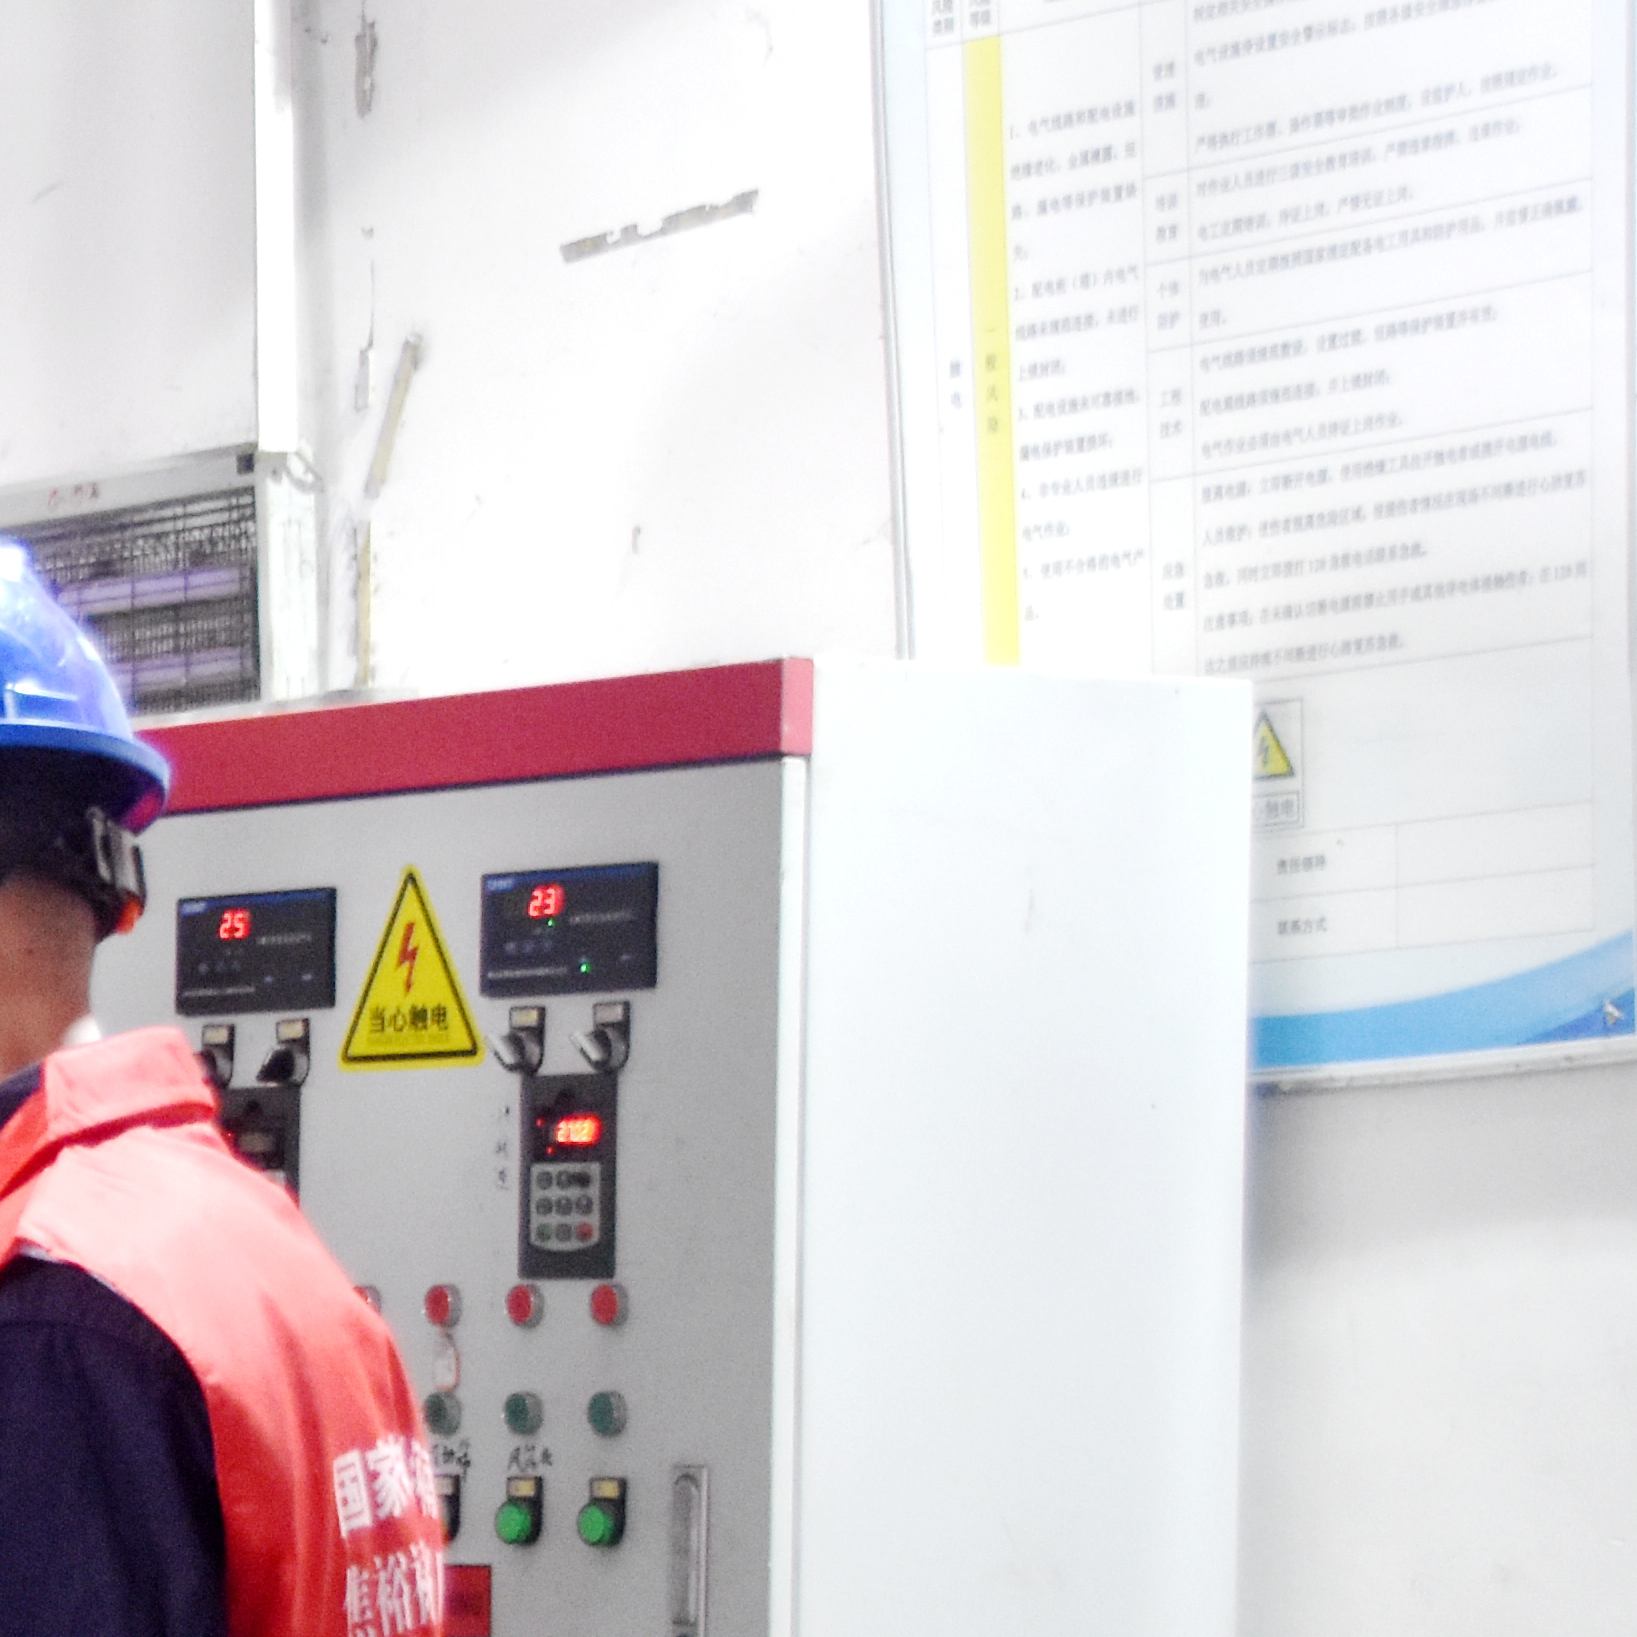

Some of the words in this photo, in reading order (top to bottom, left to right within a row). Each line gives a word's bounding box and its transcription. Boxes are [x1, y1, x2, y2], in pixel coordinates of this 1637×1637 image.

[528, 884, 562, 919] 23
[218, 909, 251, 941] 25
[369, 1004, 448, 1033] 当心触电
